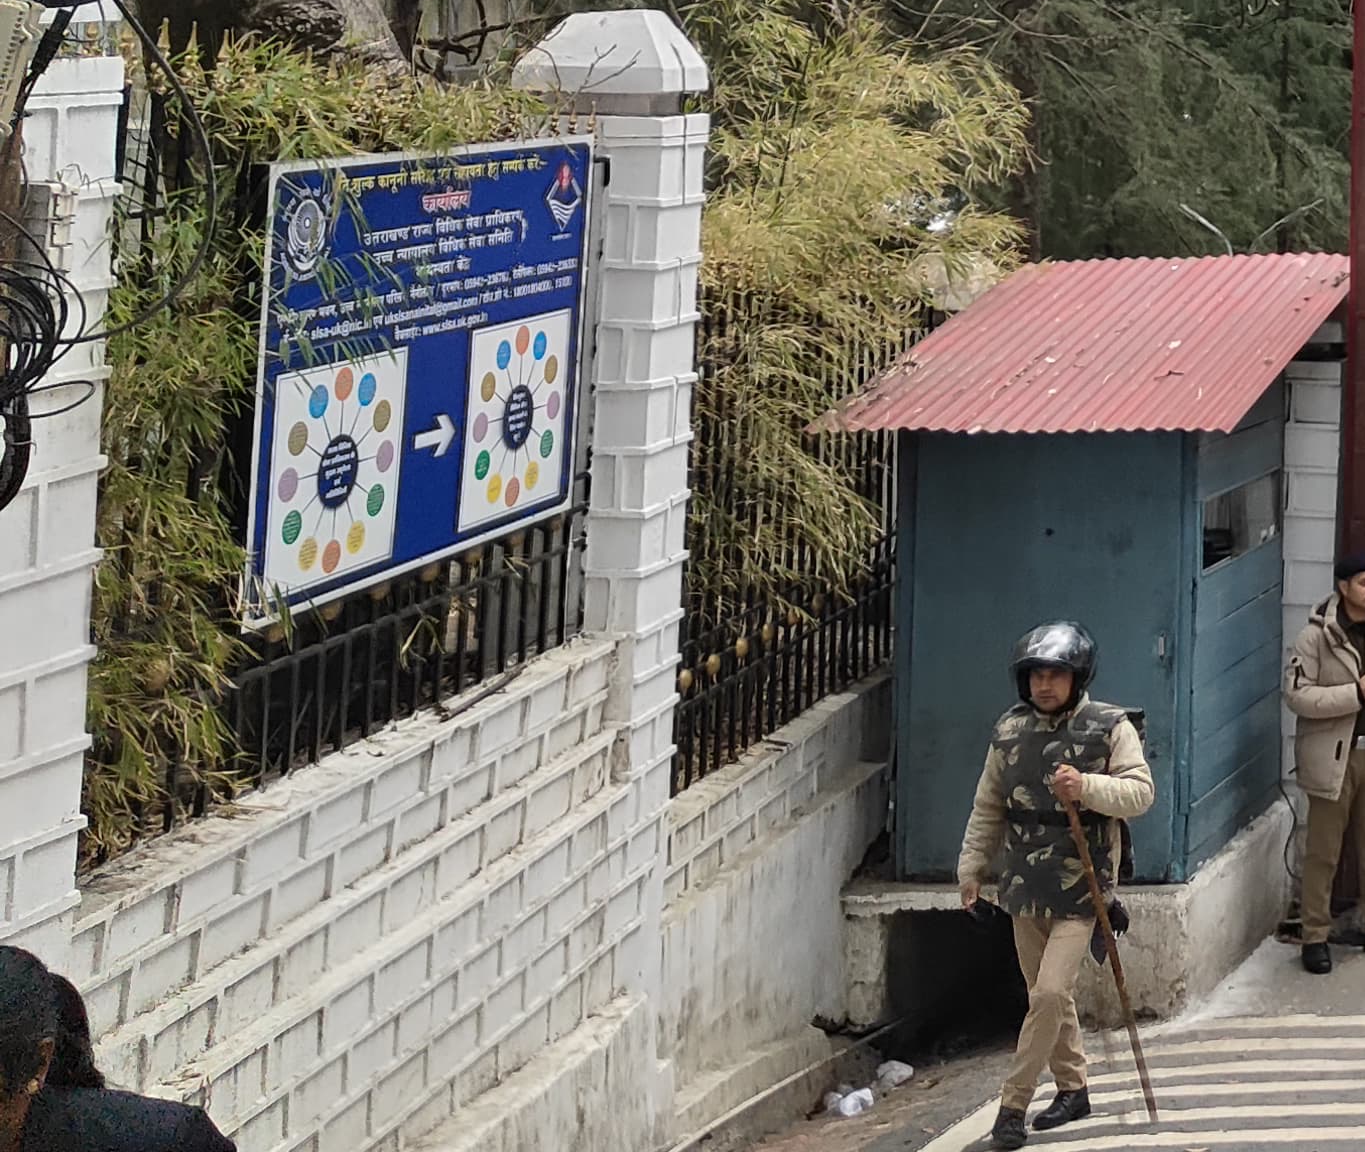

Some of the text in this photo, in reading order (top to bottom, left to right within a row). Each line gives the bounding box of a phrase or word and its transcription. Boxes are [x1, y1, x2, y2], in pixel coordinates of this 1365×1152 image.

[422, 186, 472, 214] कार्यालय
[436, 218, 462, 235] विधिक
[466, 214, 483, 231] सेवा
[438, 238, 466, 254] विधिक
[469, 234, 486, 250] सेवा
